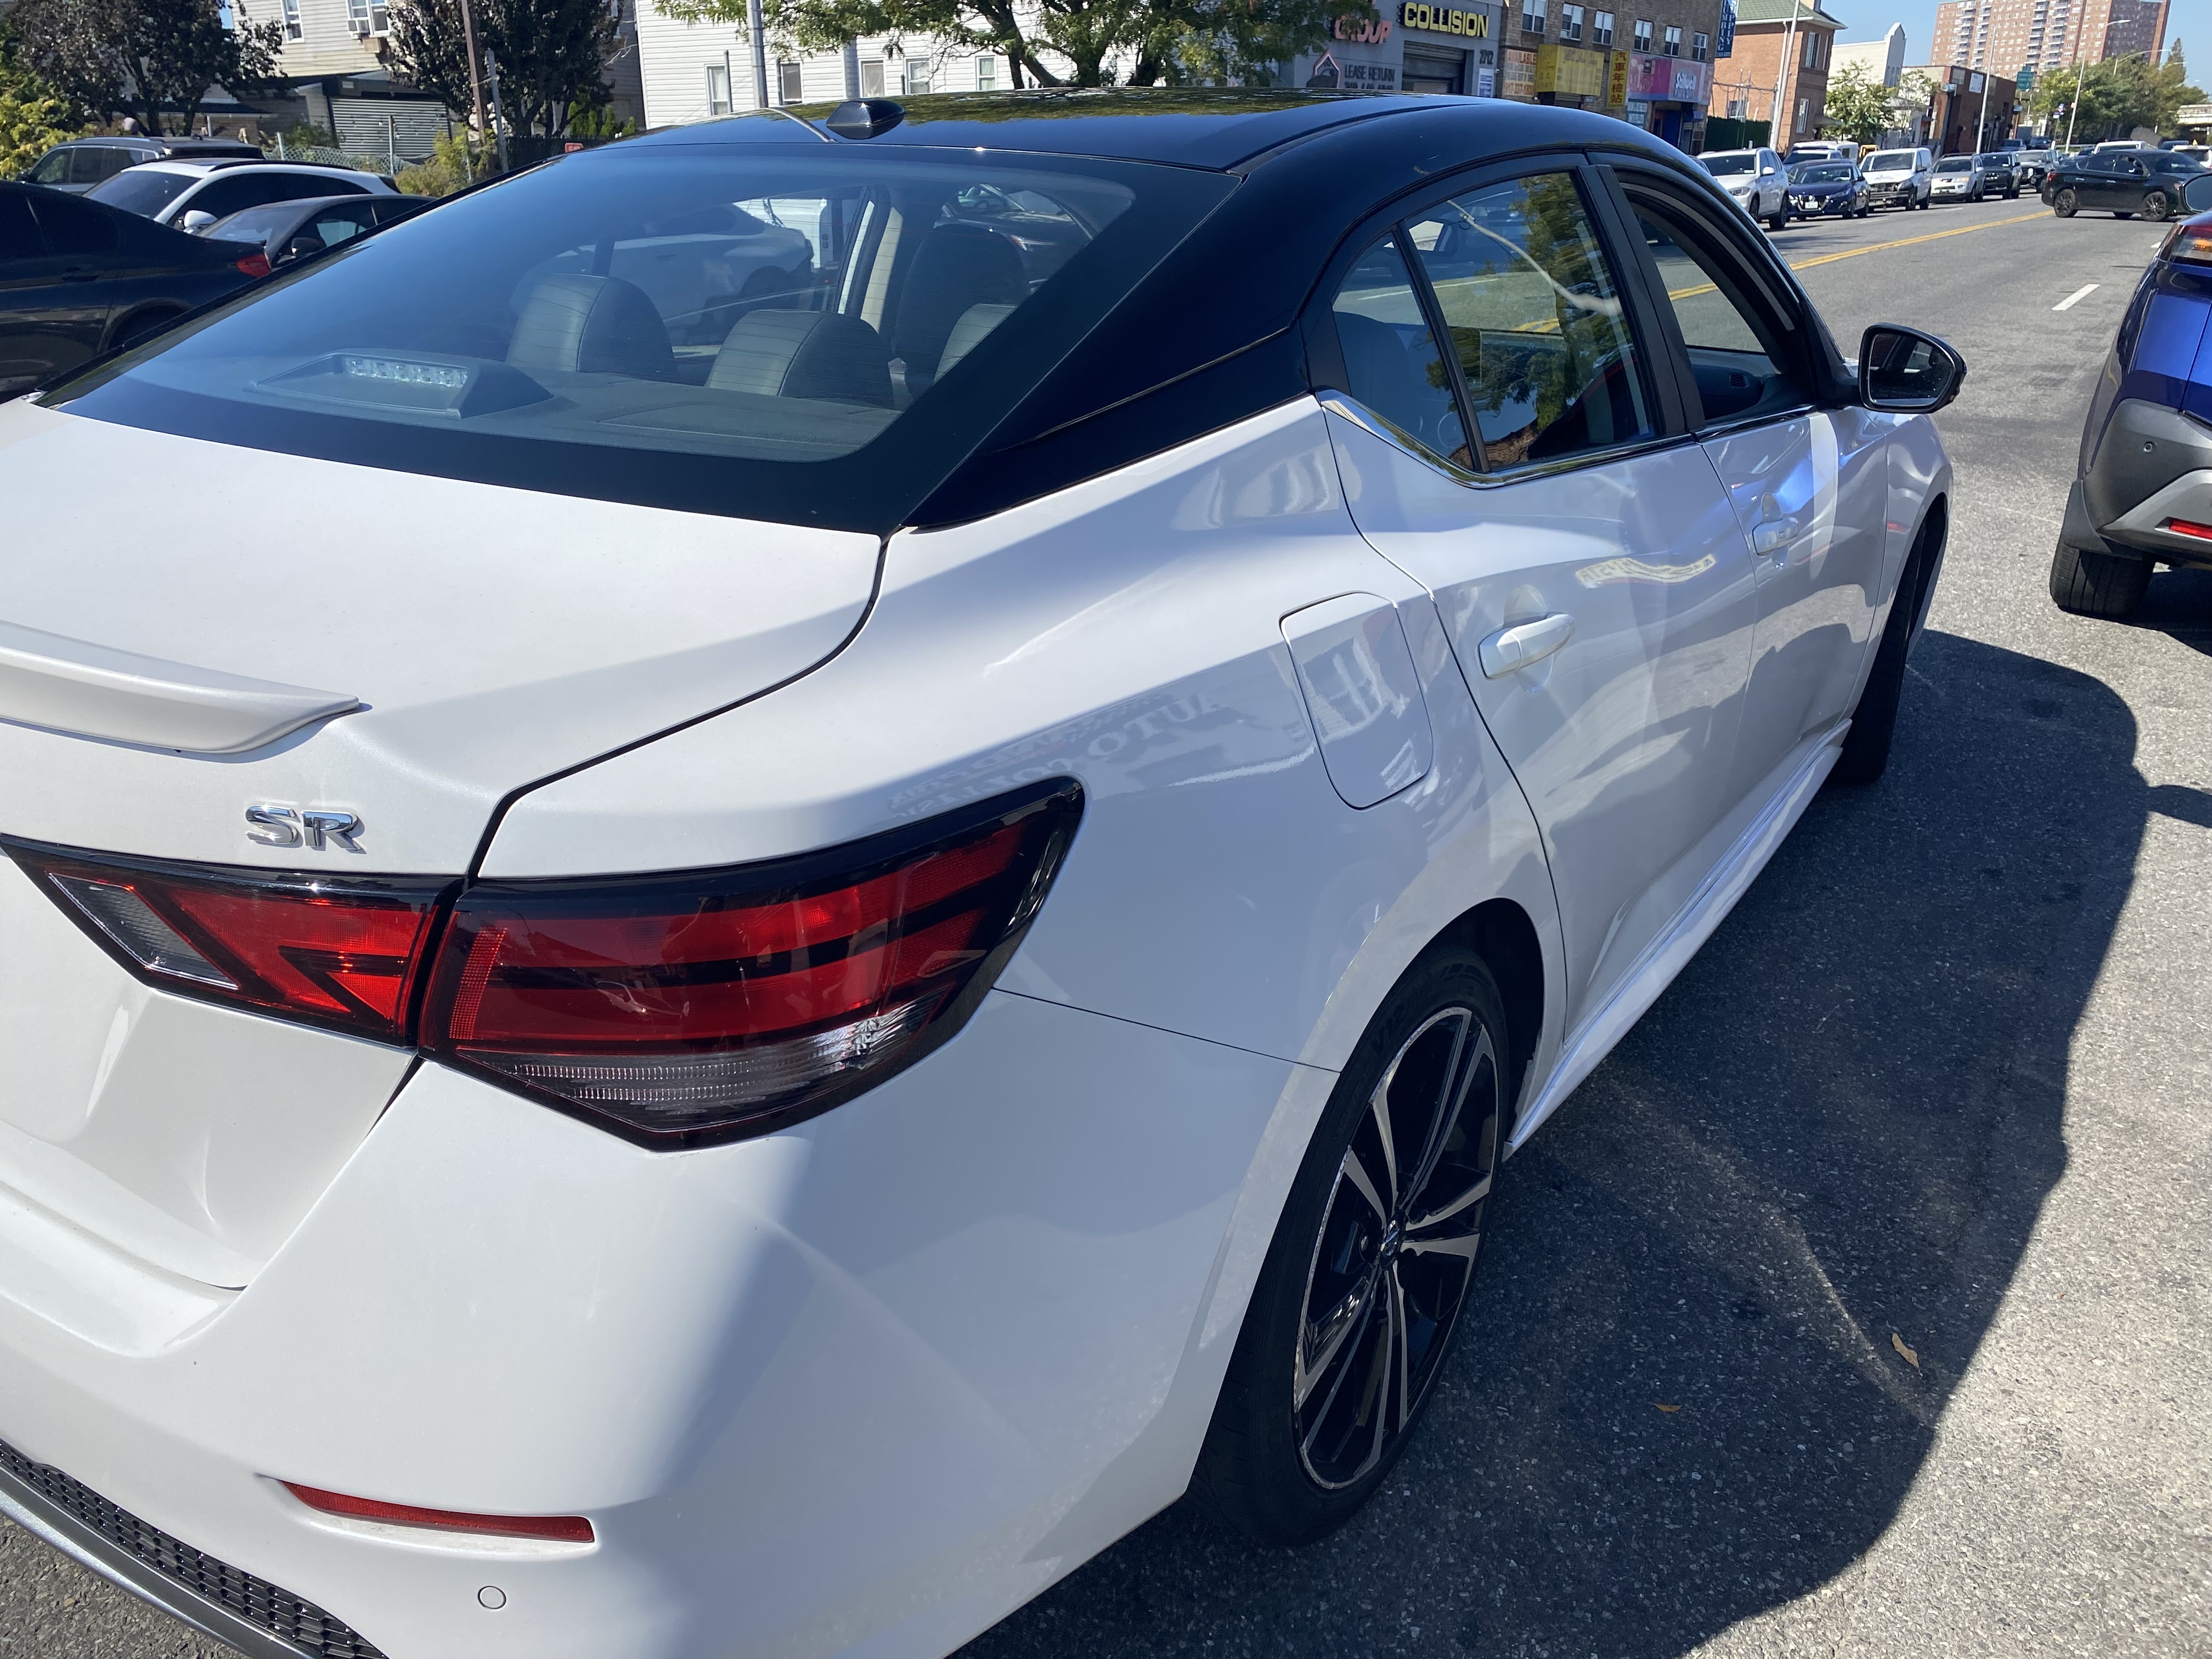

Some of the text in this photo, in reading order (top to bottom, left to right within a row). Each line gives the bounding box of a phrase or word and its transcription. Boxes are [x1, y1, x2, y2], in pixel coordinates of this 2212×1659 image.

[1404, 2, 1489, 38] COLLISION
[1345, 64, 1396, 82] LEASE RETURN
[1610, 52, 1627, 103] 汽車年檢站
[245, 805, 359, 850] SR
